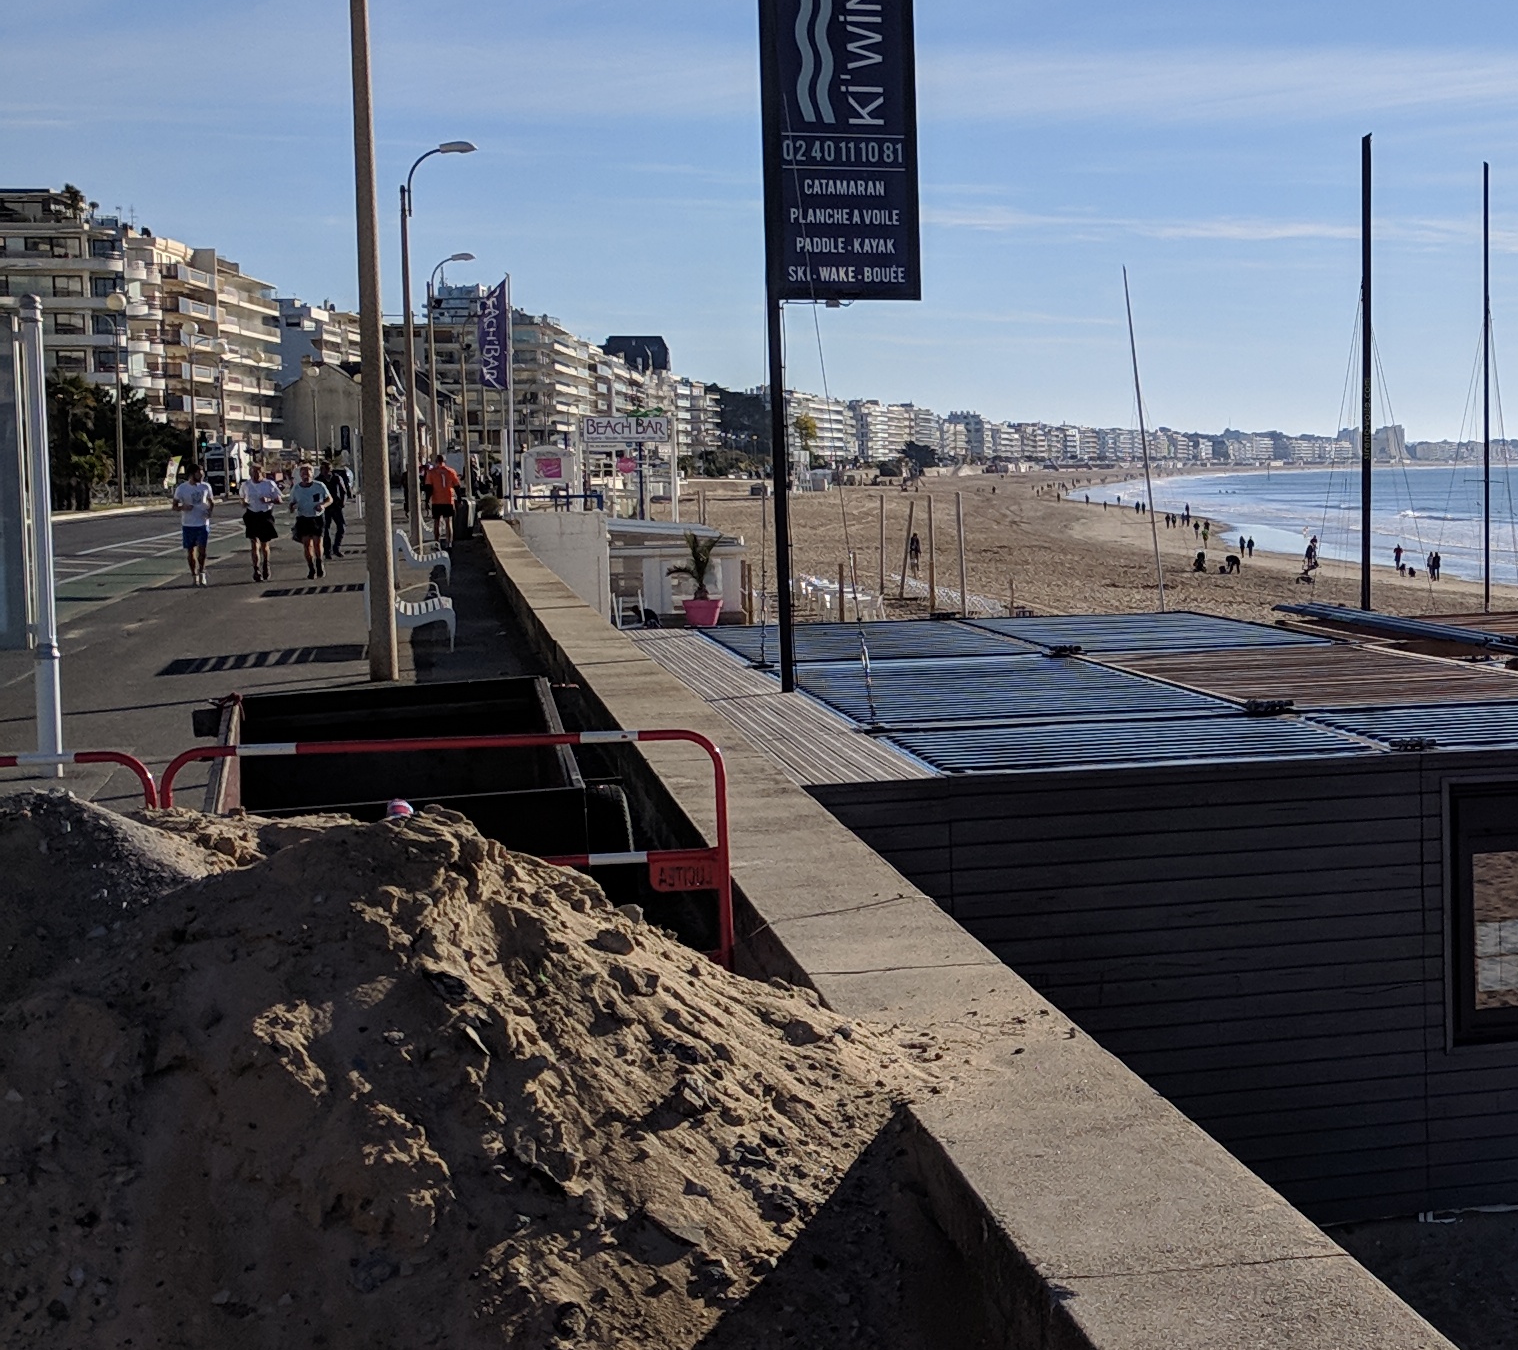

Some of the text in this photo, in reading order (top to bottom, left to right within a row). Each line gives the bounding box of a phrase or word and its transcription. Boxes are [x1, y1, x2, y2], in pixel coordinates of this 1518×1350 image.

[811, 140, 835, 162] 40
[804, 179, 885, 196] CATAMARAN
[790, 207, 900, 225] PLANCHE A VOILE
[796, 237, 896, 254] PADDLE KAYAK
[788, 264, 906, 283] SKI WAKE BOUÉE
[586, 417, 665, 436] BEACH BAR
